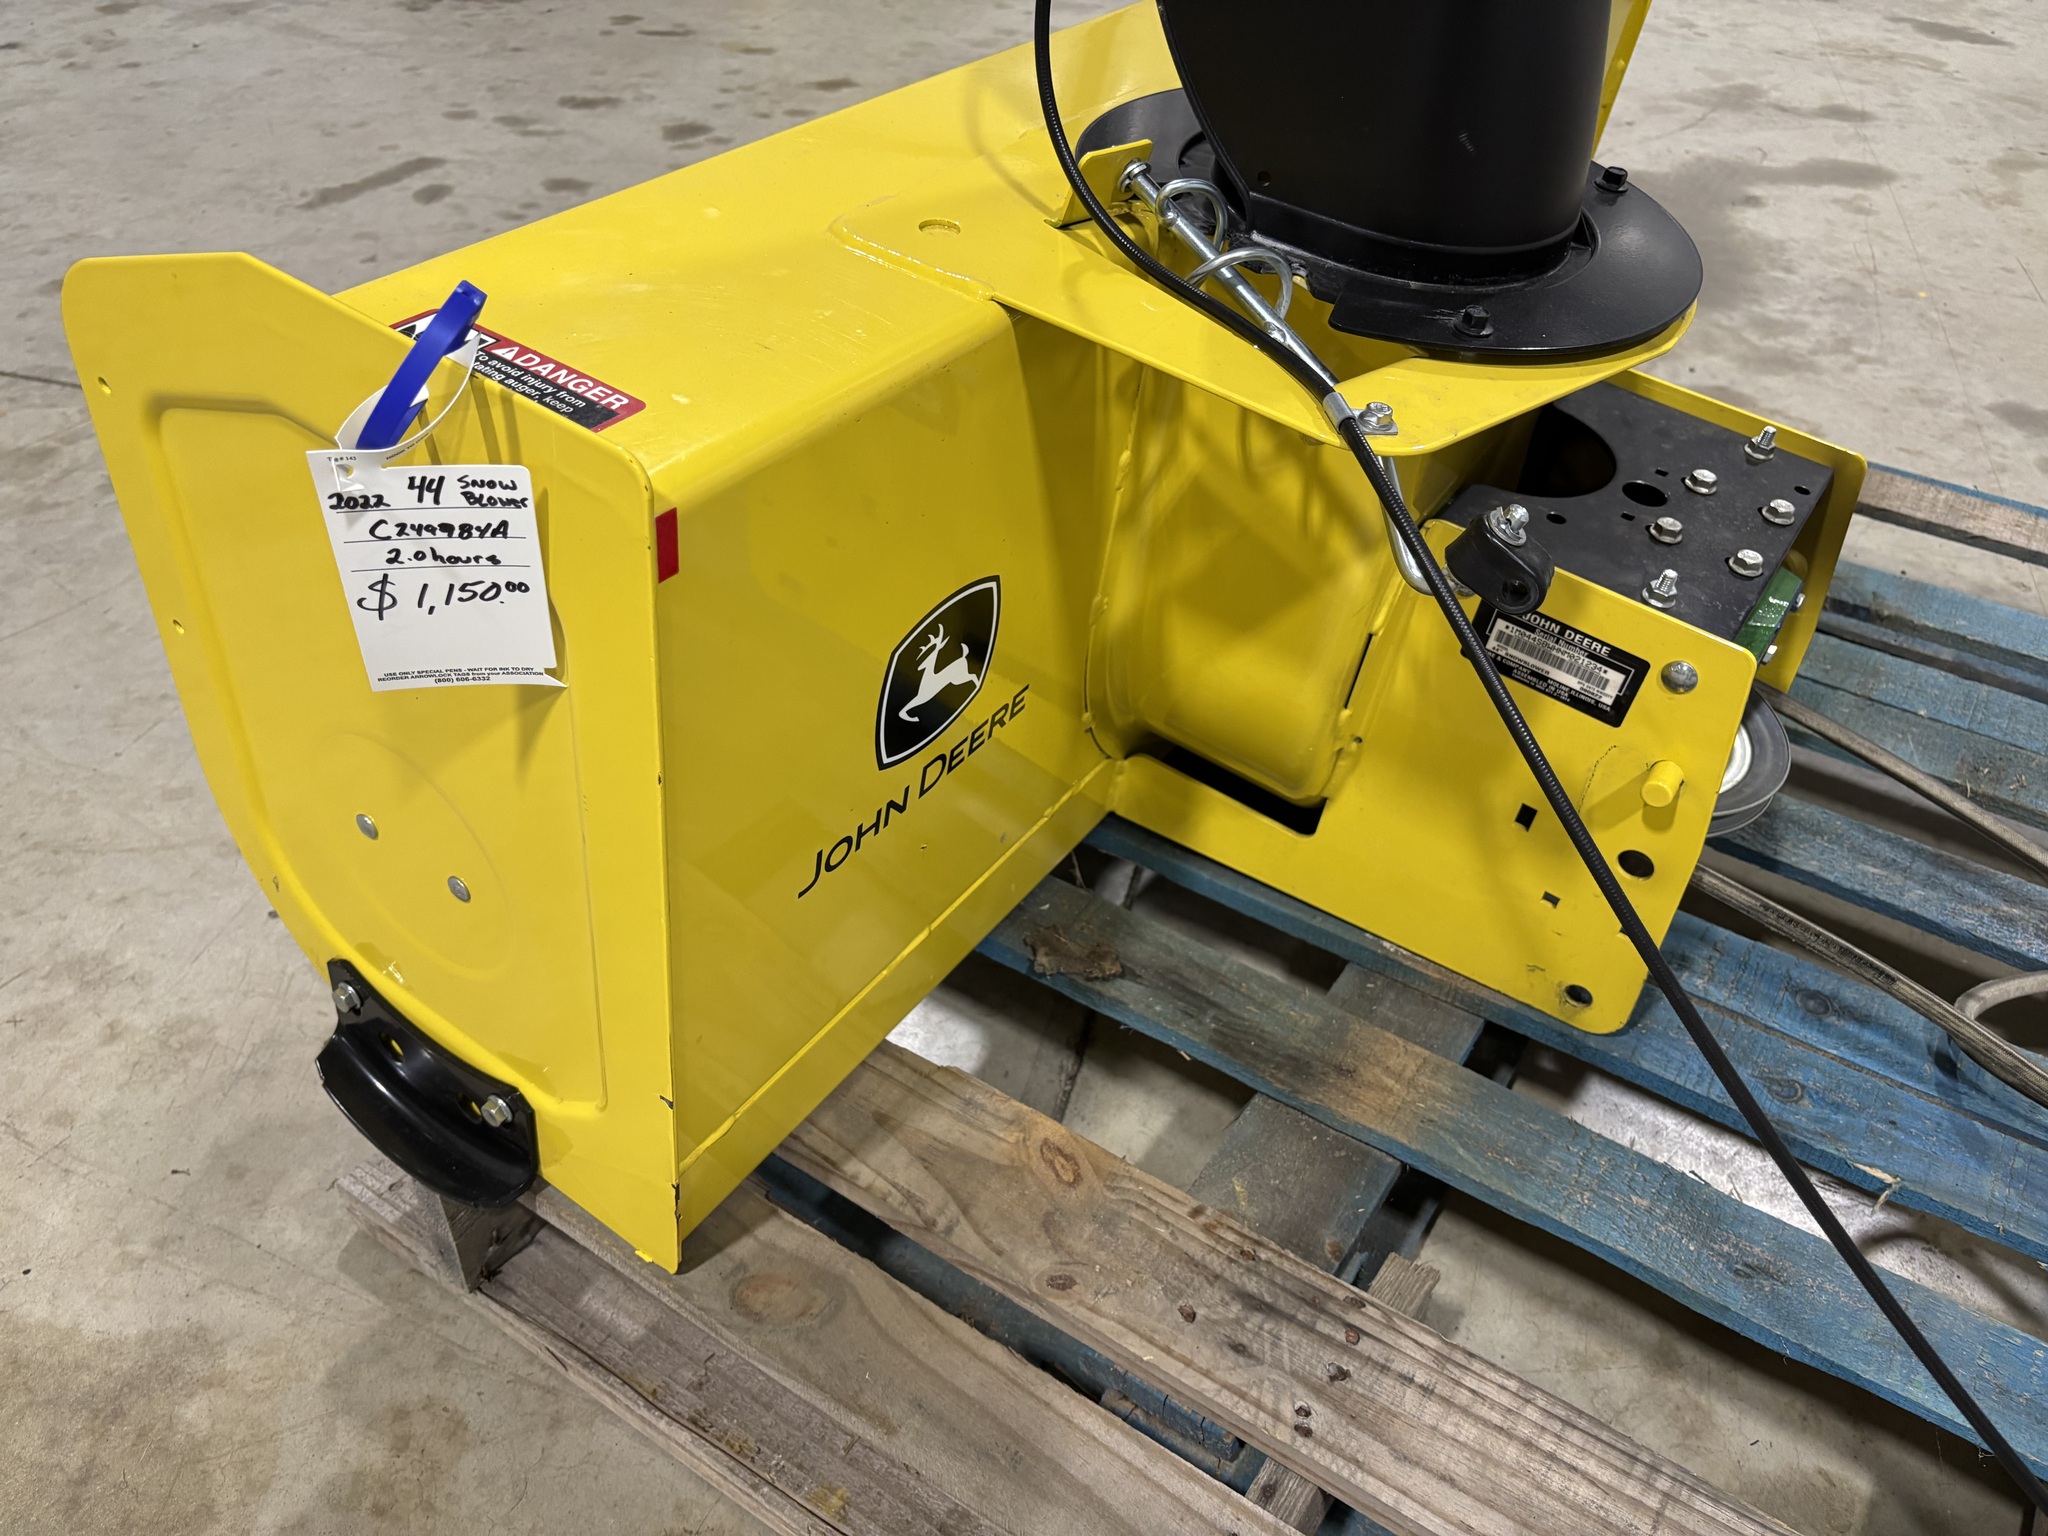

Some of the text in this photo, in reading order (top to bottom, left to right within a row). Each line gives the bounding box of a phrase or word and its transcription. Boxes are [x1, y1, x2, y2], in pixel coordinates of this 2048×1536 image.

[476, 351, 586, 408] To avoid injury from
[504, 379, 541, 398] auger,
[542, 396, 573, 413] keep
[513, 353, 629, 410] DANGER
[328, 474, 517, 510] 2022 44 SNOW
[1522, 613, 1611, 656] JOHN DEERE
[1535, 628, 1588, 657] Serial Number
[1502, 658, 1531, 673] COMPANY
[1505, 652, 1549, 675] SNOWBLOWER
[1512, 668, 1547, 687] ASSEMBLED
[1556, 688, 1569, 697] USA
[1597, 702, 1611, 712] USA
[798, 684, 1030, 899] JOHN DEERE
